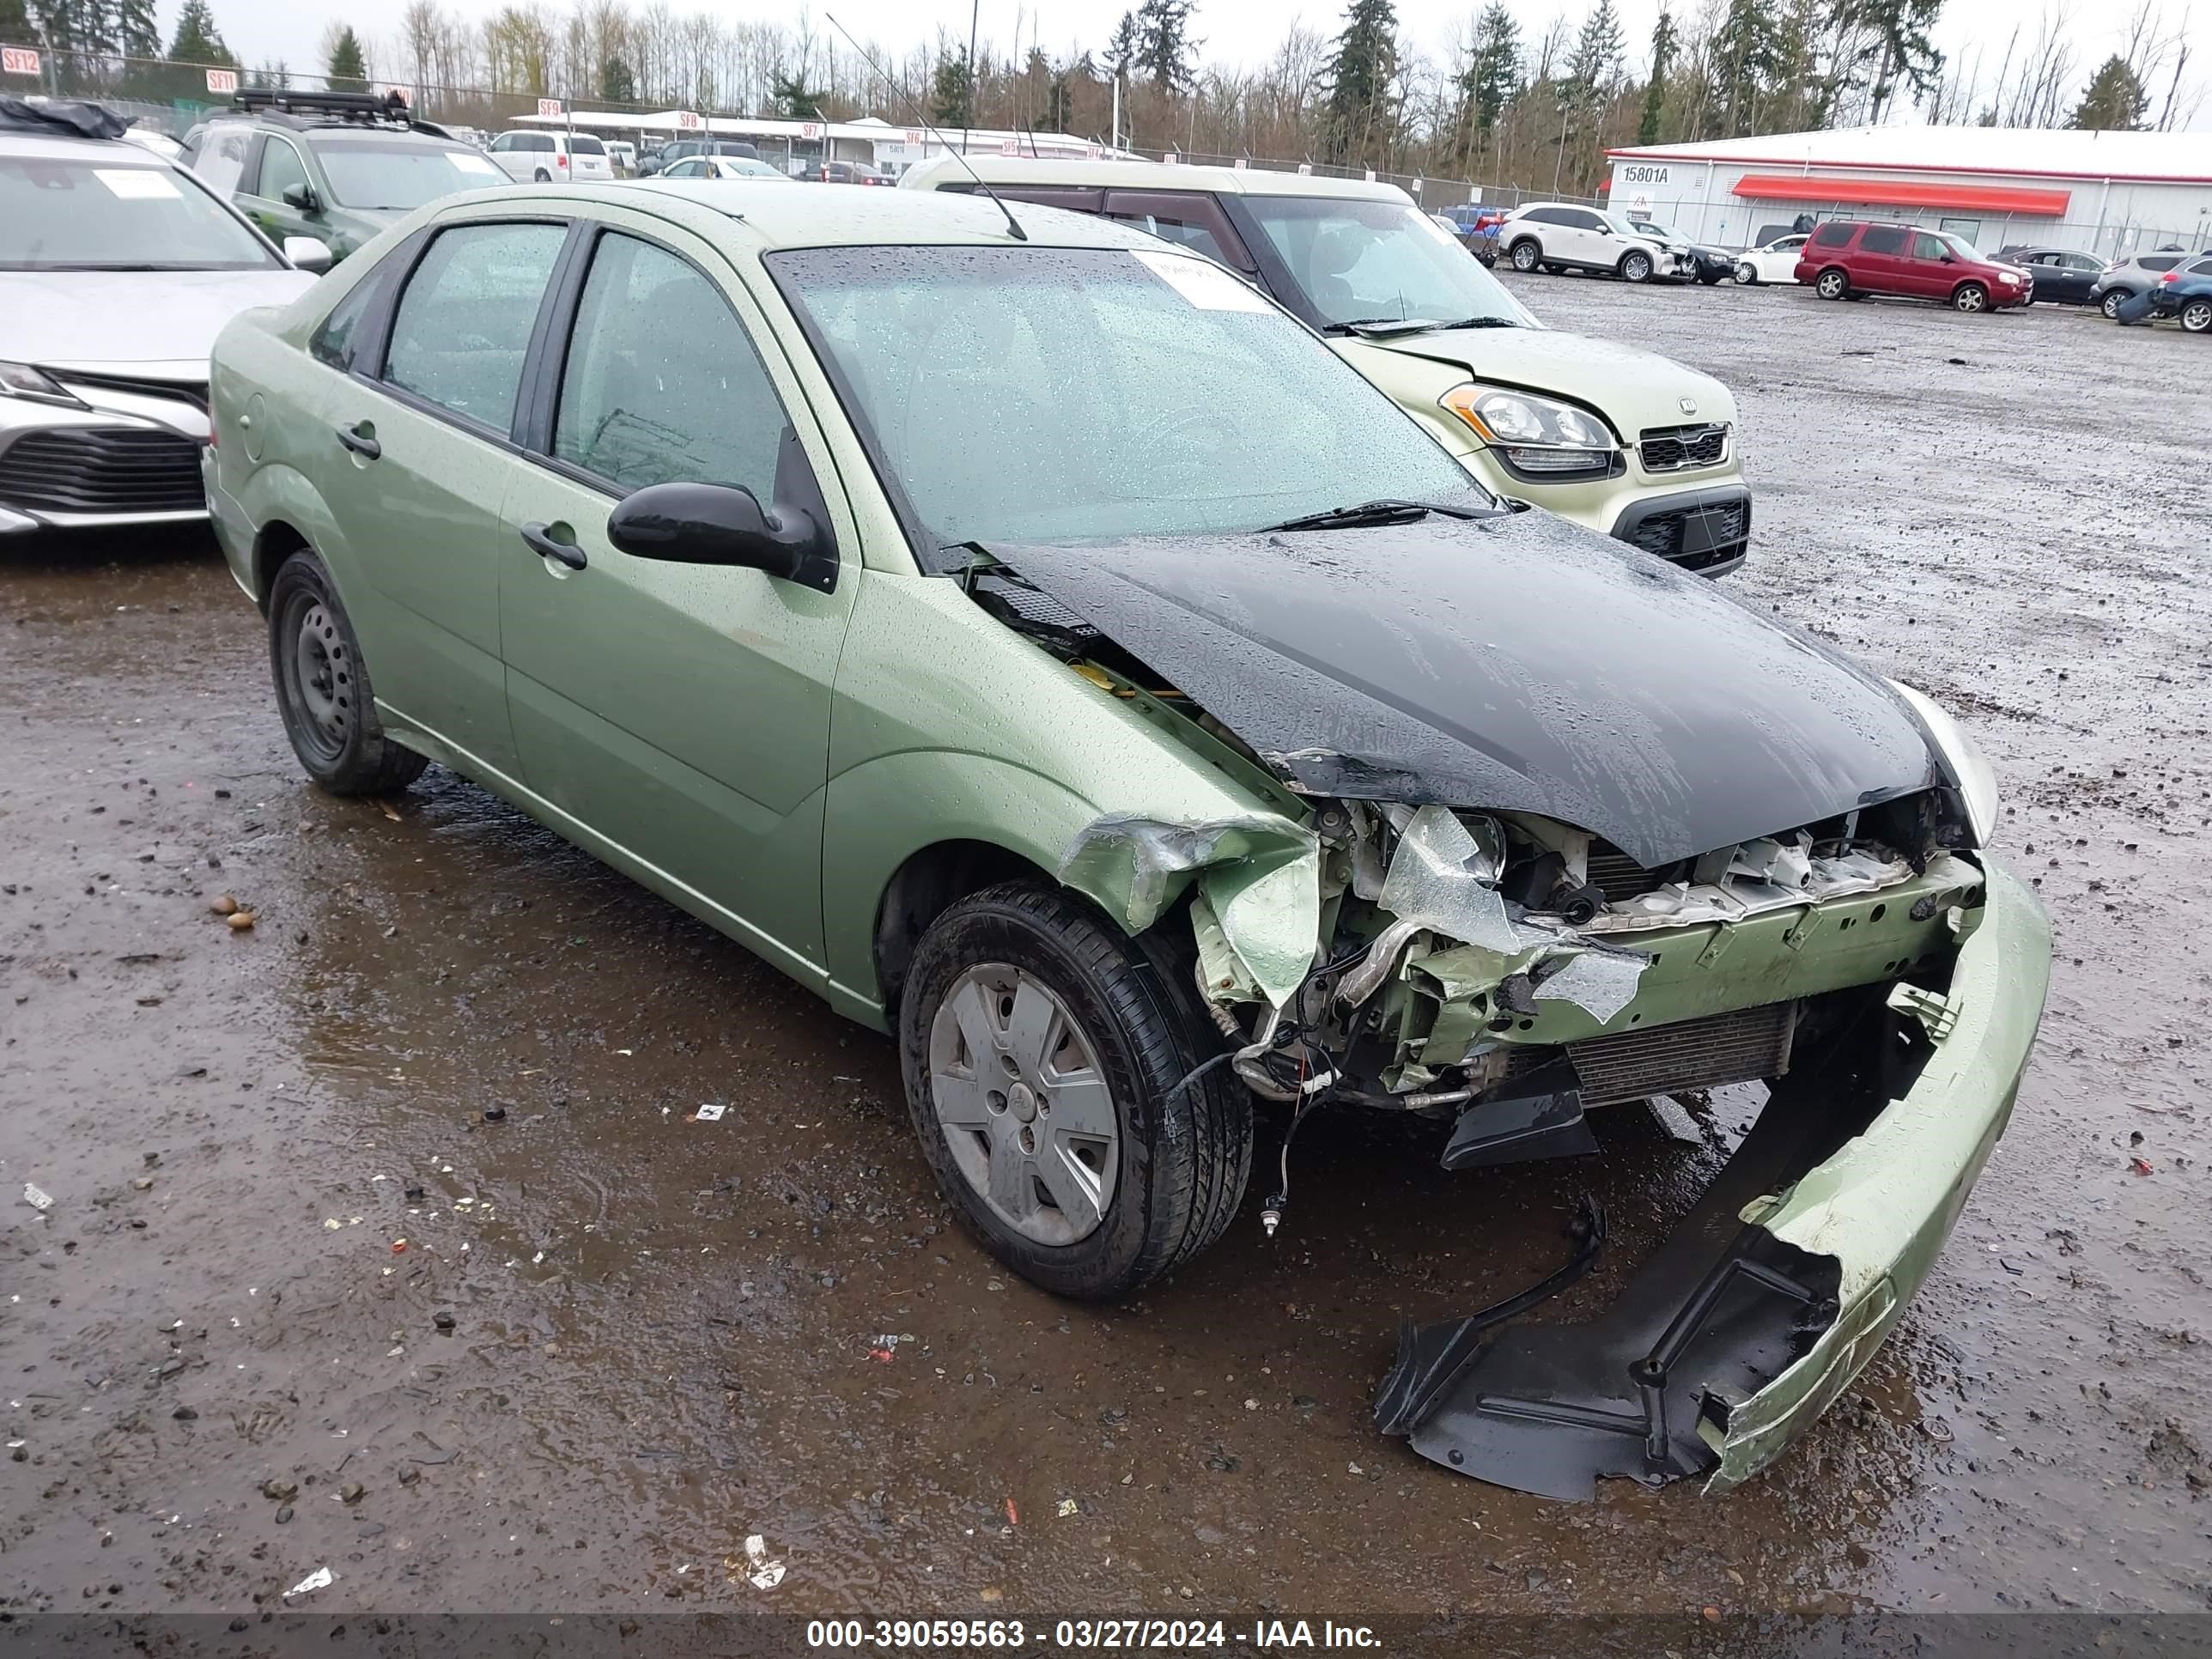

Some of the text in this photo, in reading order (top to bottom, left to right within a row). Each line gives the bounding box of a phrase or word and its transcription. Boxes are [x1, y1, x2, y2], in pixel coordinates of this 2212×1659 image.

[3, 50, 38, 71] SF12
[209, 71, 235, 90] SF11
[540, 100, 560, 116] SF9
[680, 112, 697, 128] SF8
[803, 124, 817, 137] SF7
[906, 131, 920, 144] SF6
[1004, 141, 1017, 152] SF5
[1623, 166, 1668, 183] 15801A
